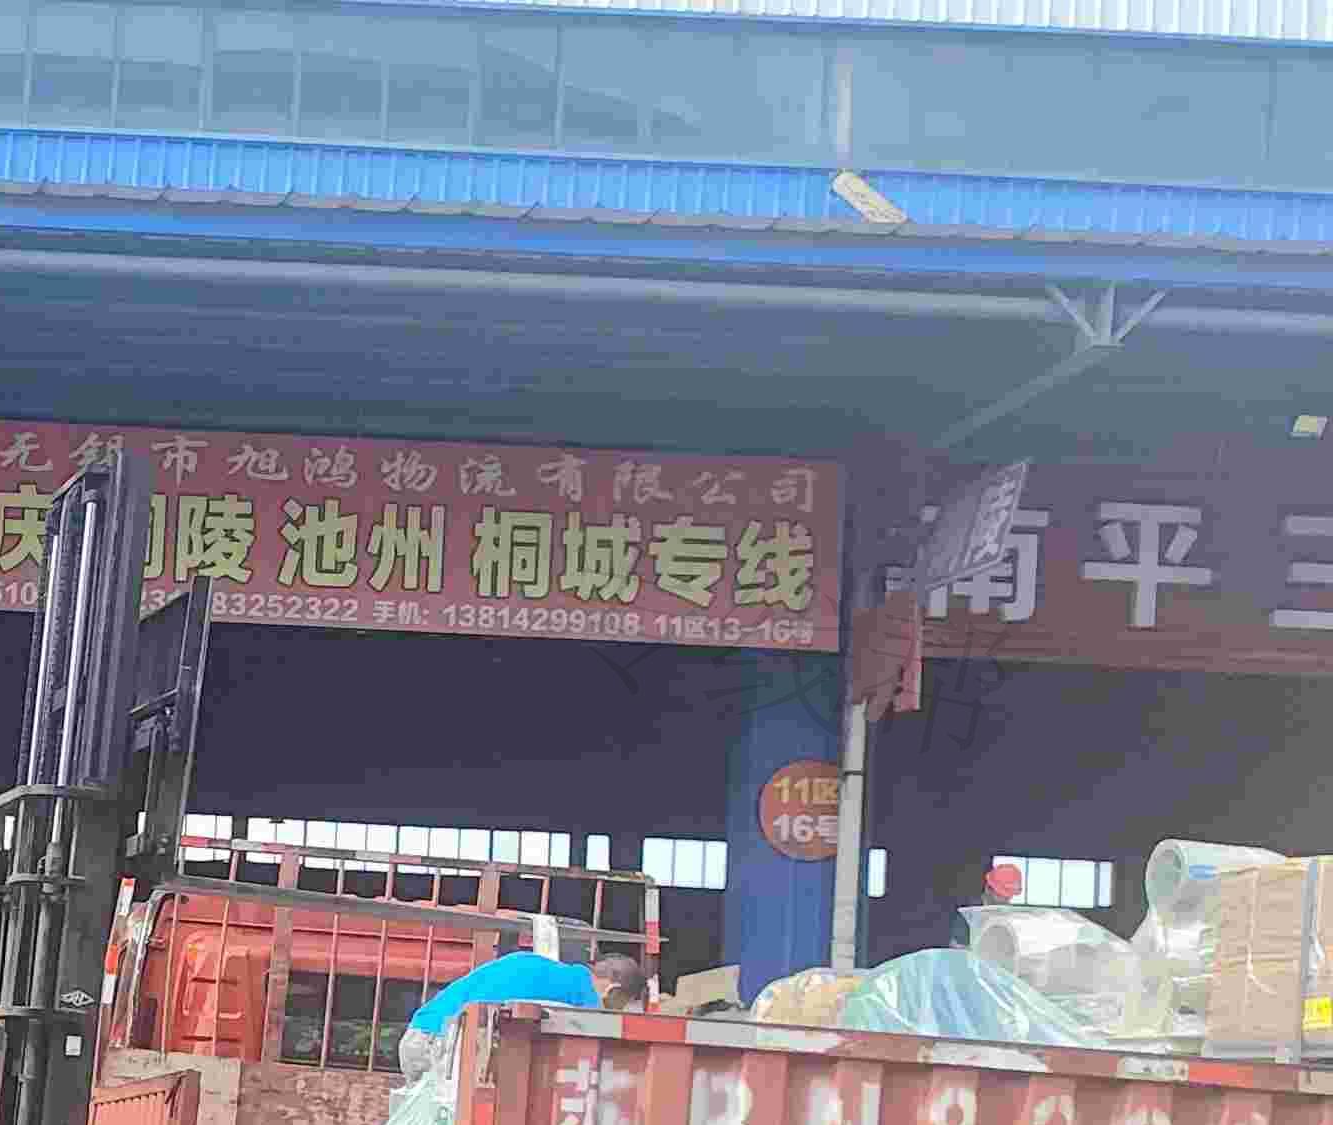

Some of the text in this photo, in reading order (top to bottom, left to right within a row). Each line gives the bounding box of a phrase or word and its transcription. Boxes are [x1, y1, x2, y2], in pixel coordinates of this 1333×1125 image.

[144, 491, 256, 584] 陵
[277, 497, 445, 592] 池州
[472, 504, 815, 611] 桐城专线
[212, 591, 358, 623] 83252322
[443, 605, 640, 637] 13814299108
[771, 776, 838, 806] 11区
